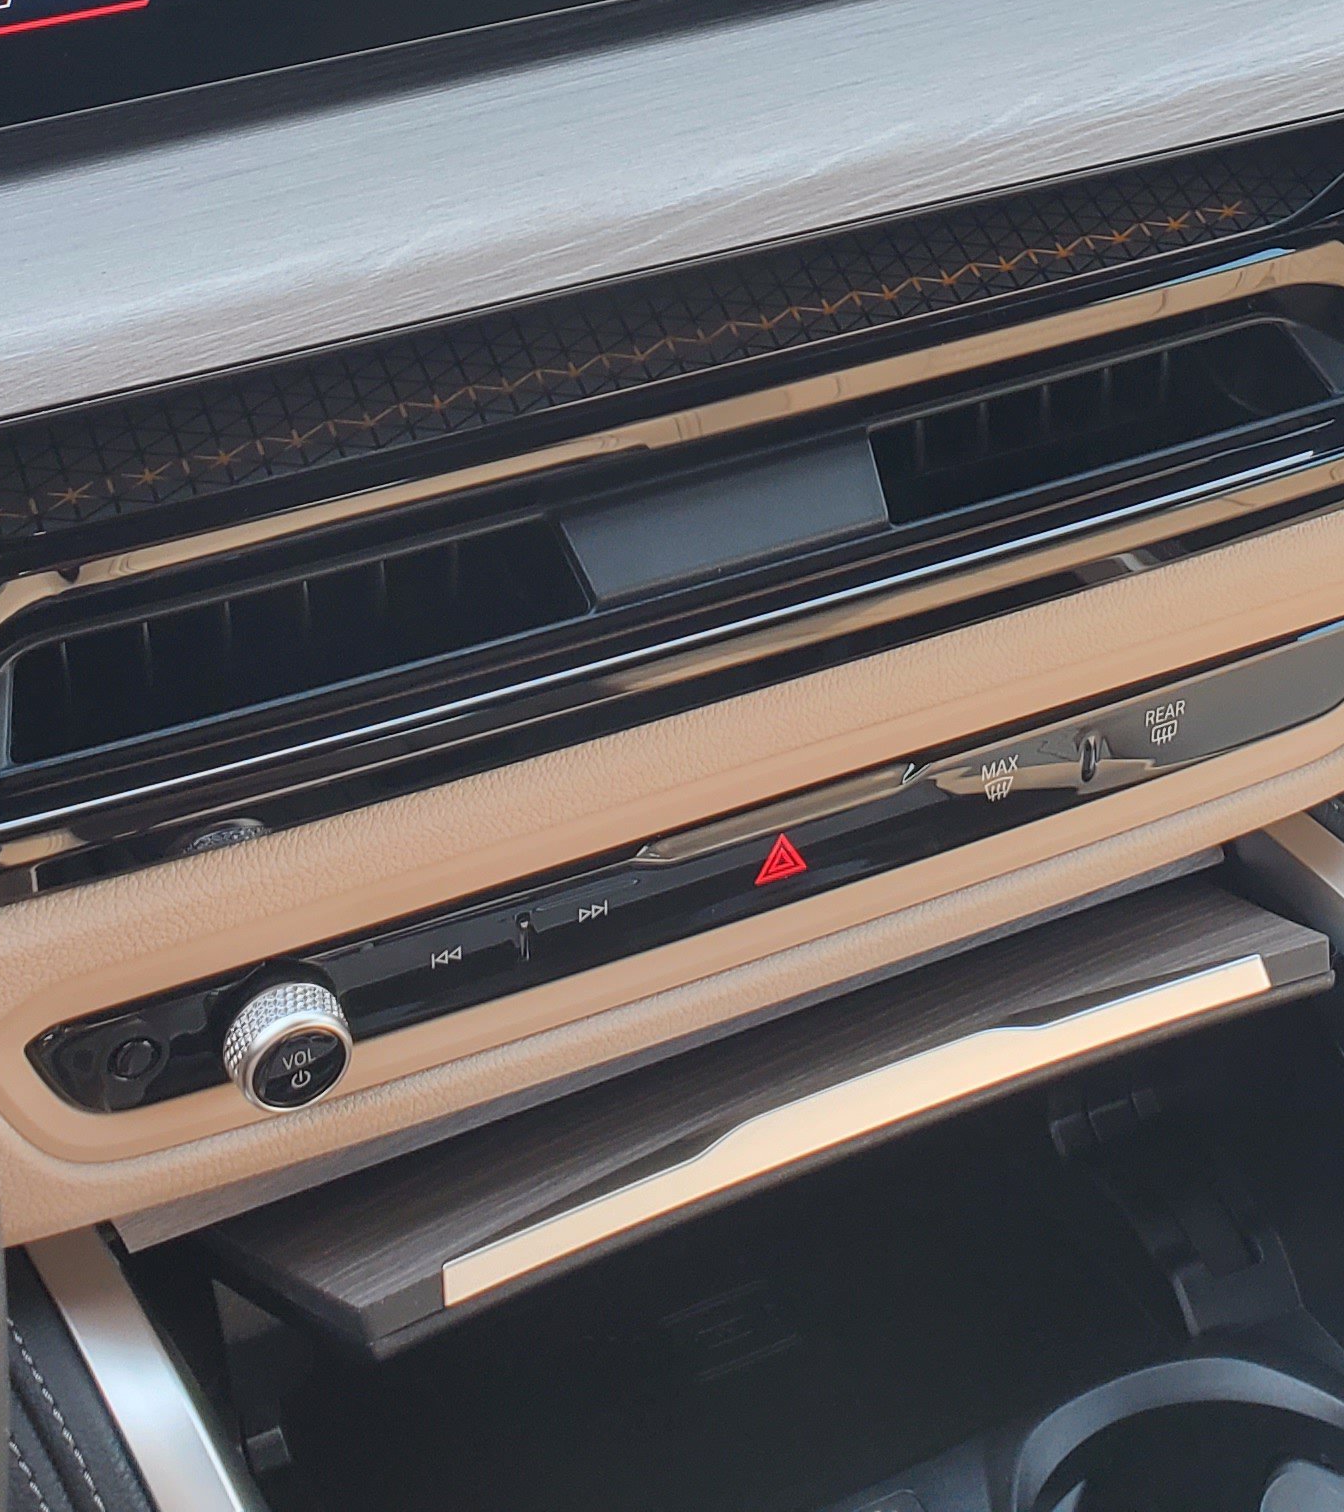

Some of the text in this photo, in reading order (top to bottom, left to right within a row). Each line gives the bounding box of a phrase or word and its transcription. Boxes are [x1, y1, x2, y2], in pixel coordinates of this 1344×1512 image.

[1144, 699, 1186, 727] REAR
[981, 754, 1019, 781] MAX
[282, 1047, 317, 1071] VOL
